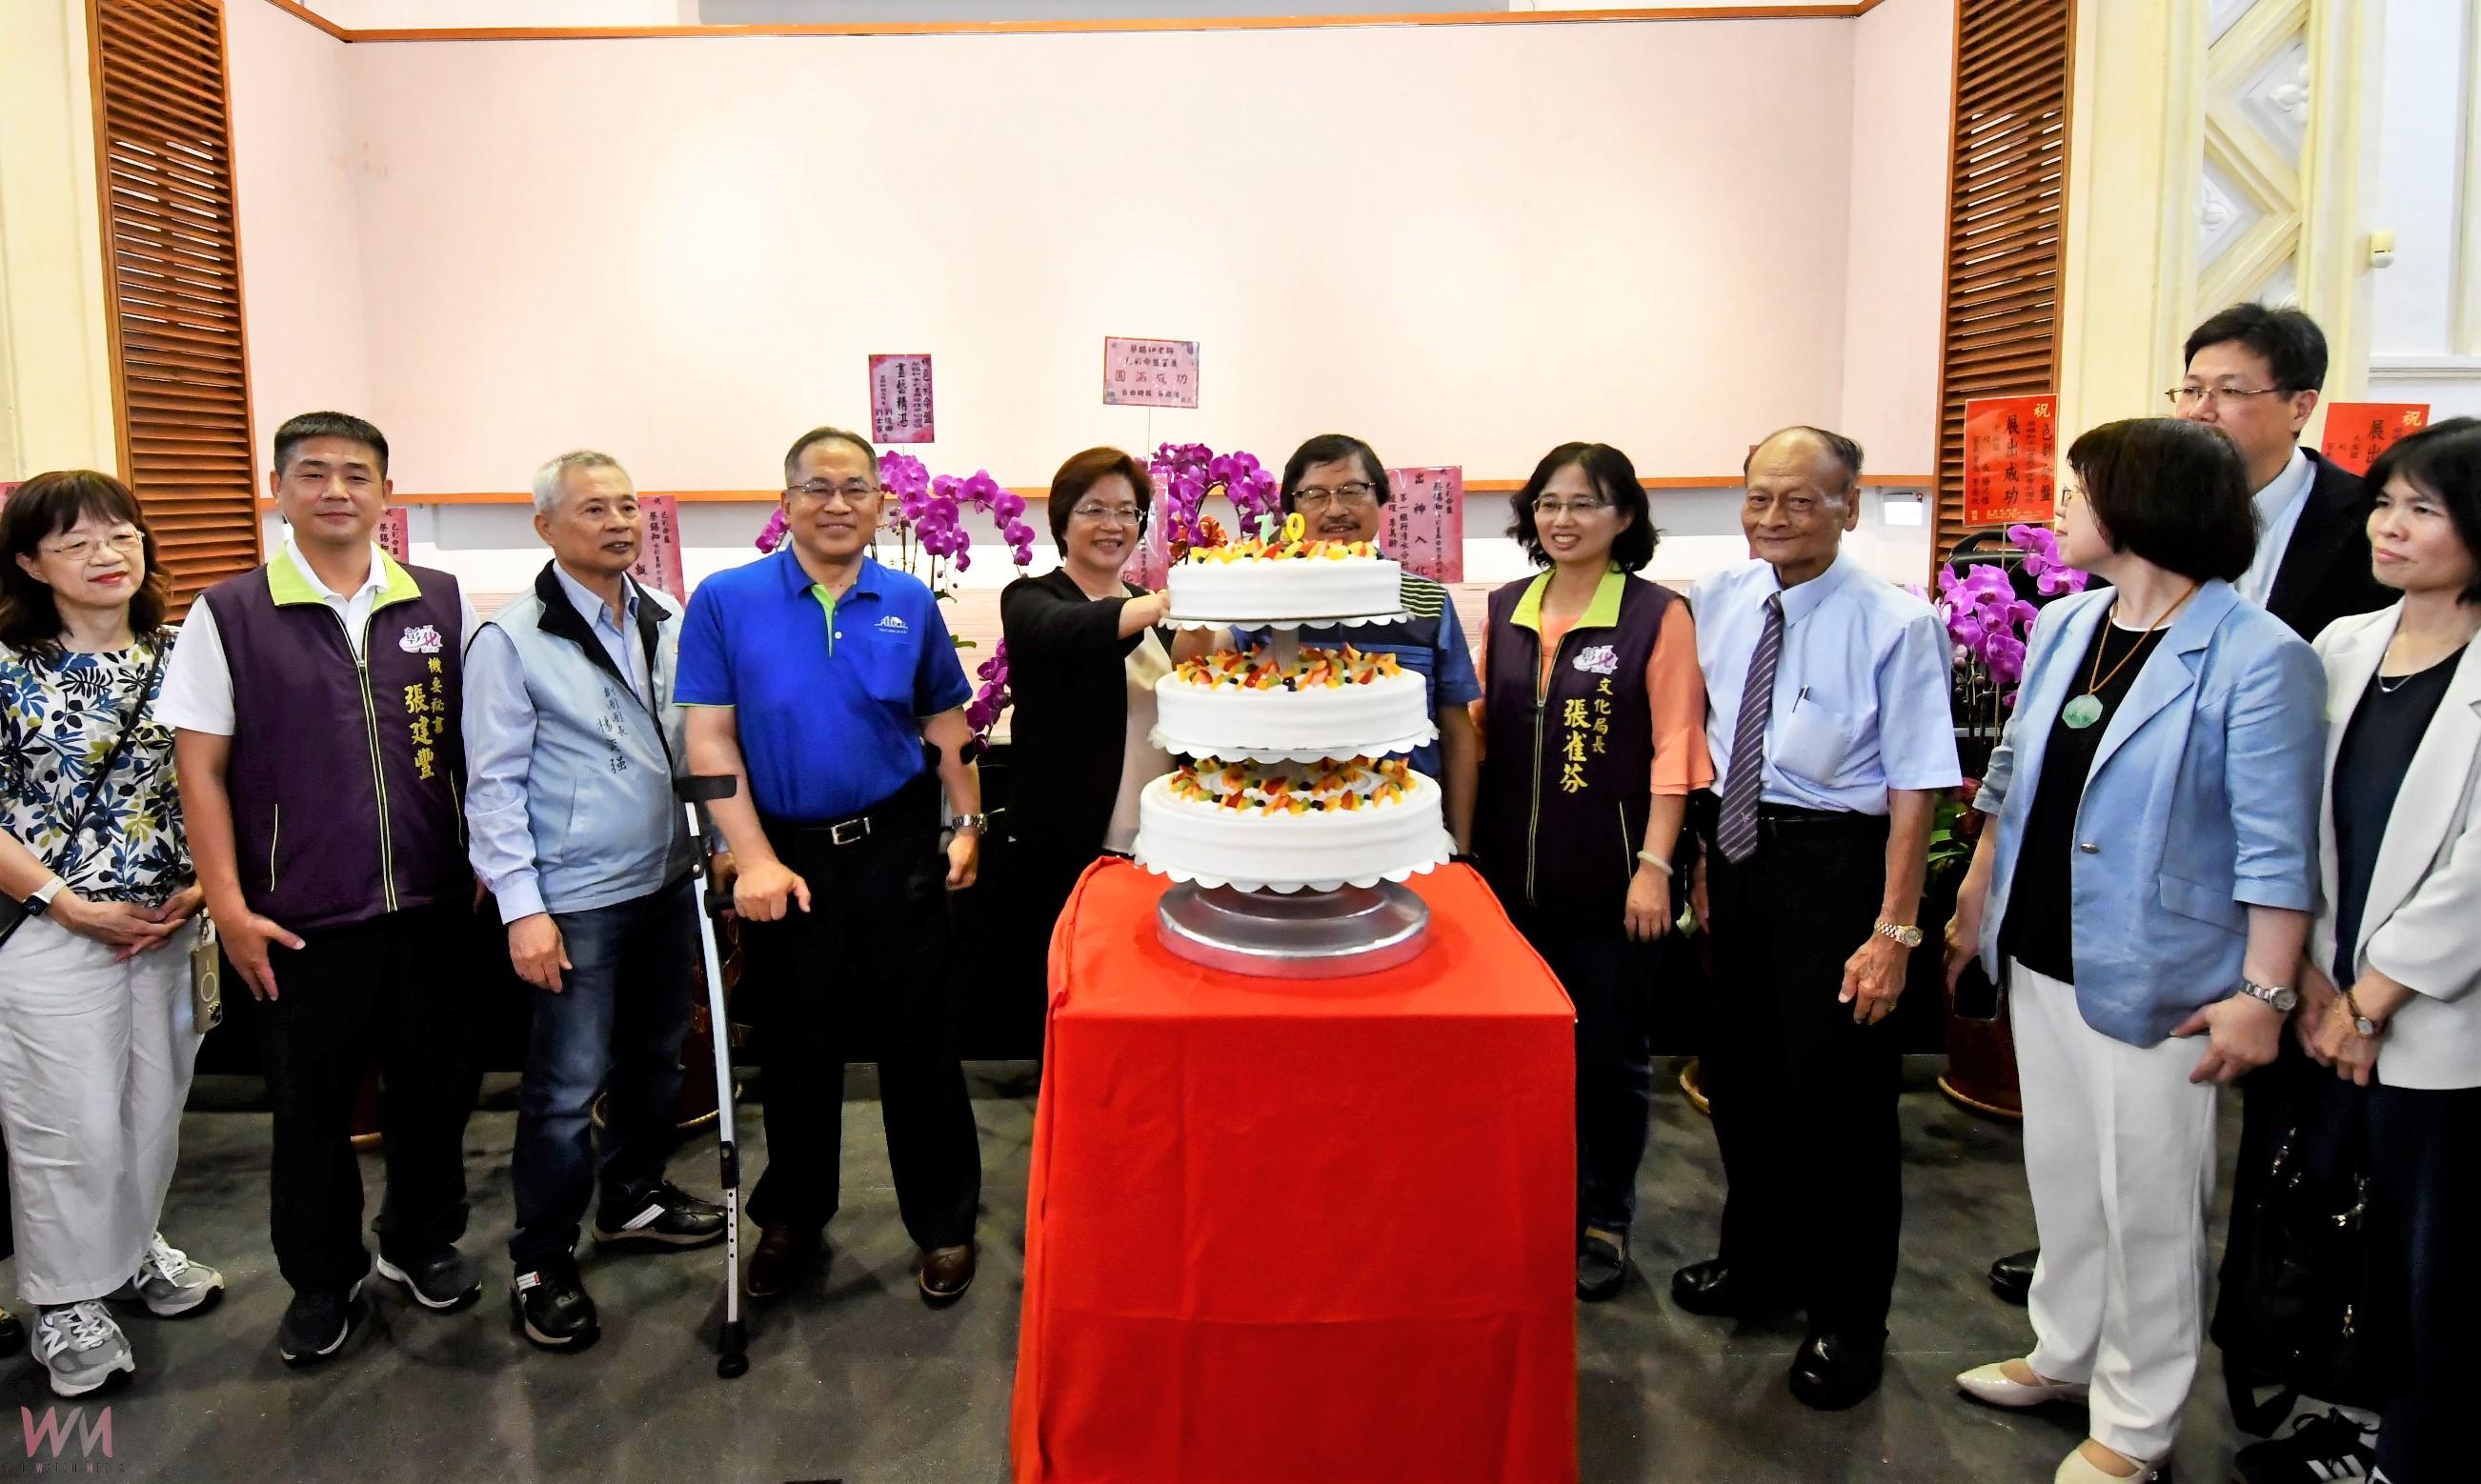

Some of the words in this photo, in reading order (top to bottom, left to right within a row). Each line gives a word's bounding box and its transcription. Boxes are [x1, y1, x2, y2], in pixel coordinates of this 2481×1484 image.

[1115, 370, 1188, 384] 圓滿成功
[2033, 403, 2051, 418] 祝
[2403, 411, 2422, 427] 祝
[2005, 414, 2020, 505] 展出成功
[1413, 472, 1428, 575] 出神入化
[404, 683, 435, 781] 張建豐
[1560, 699, 1592, 793] 張雀芬
[1592, 677, 1614, 754] 文化局長
